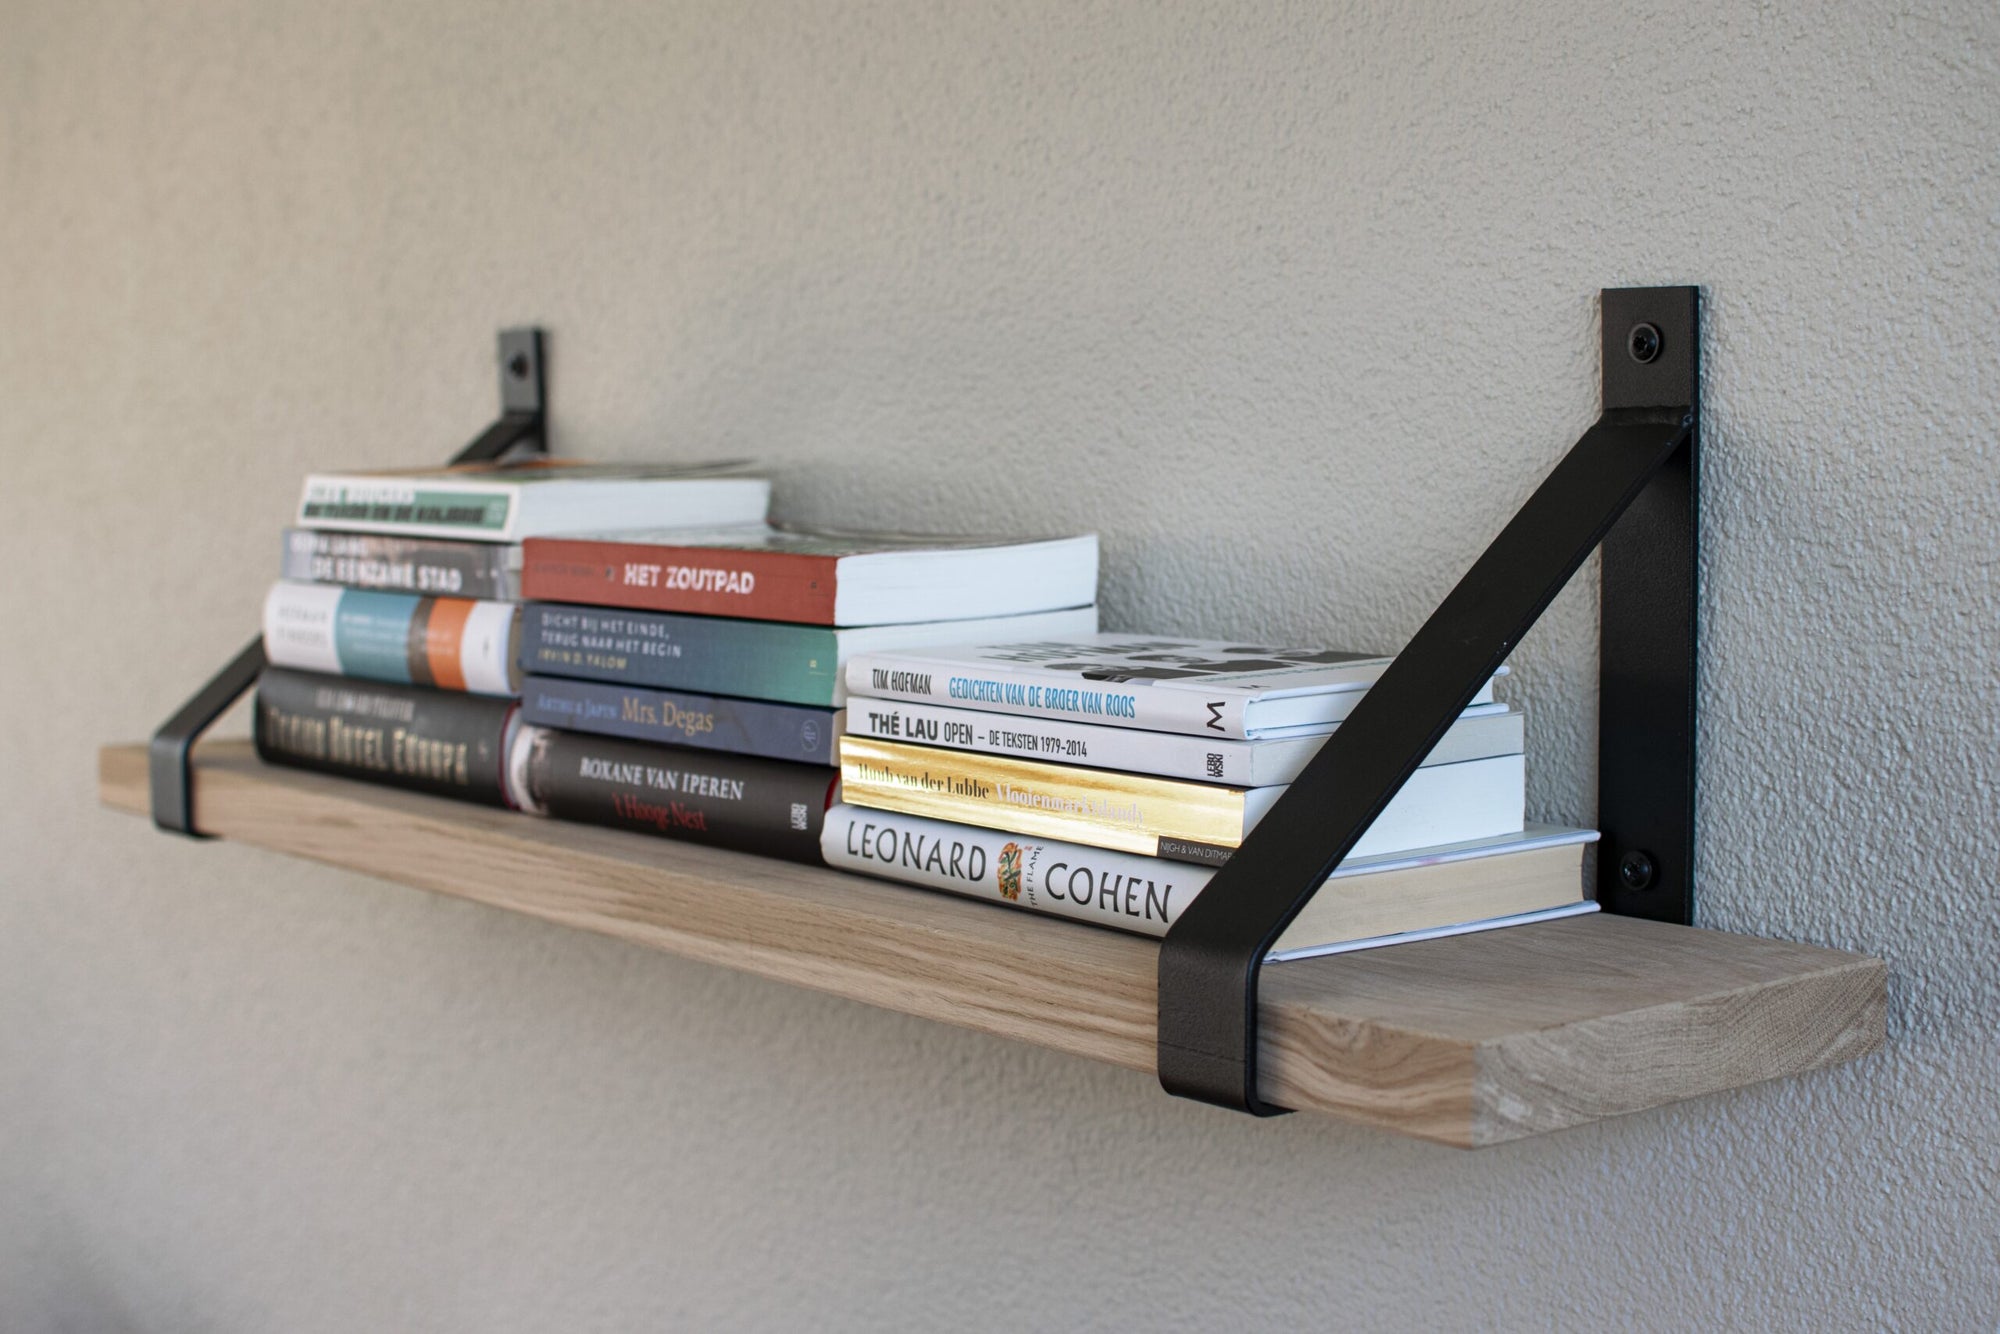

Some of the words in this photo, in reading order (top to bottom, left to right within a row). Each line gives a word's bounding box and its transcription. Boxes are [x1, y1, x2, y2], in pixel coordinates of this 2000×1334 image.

[417, 564, 463, 592] STAD
[624, 562, 660, 588] HET
[666, 566, 755, 595] ZOUTPAD
[601, 619, 624, 634] HET
[582, 635, 613, 650] NAAR
[616, 638, 640, 654] HET
[642, 641, 681, 659] BEGIN
[872, 668, 889, 690] TIM
[891, 671, 932, 696] HOFMAN
[950, 676, 1003, 704] GEDICHTEN
[1005, 683, 1026, 707] VAN
[1028, 686, 1043, 708] DE
[1045, 688, 1079, 713] BROER
[1081, 691, 1102, 715] VAN
[1105, 693, 1136, 719] ROOS
[622, 696, 658, 724] Mrs.
[663, 701, 714, 736] Degas
[869, 710, 900, 736] THÉ
[905, 716, 938, 741] LAU
[943, 721, 973, 746] OPEN
[989, 729, 1000, 746] DE
[1002, 731, 1038, 751] TEKSTEN
[580, 757, 643, 785] ROXANE
[646, 767, 680, 790] VAN
[682, 772, 744, 800] IPEREN
[896, 772, 918, 789] van
[920, 771, 944, 792] der
[947, 776, 990, 799] Lubbe
[670, 800, 708, 832] Nest
[1026, 845, 1045, 883] FLAME
[1187, 846, 1204, 857] VAN
[847, 820, 987, 883] LEONARD
[1045, 862, 1173, 924] COHEN
[1026, 886, 1038, 906] THE
